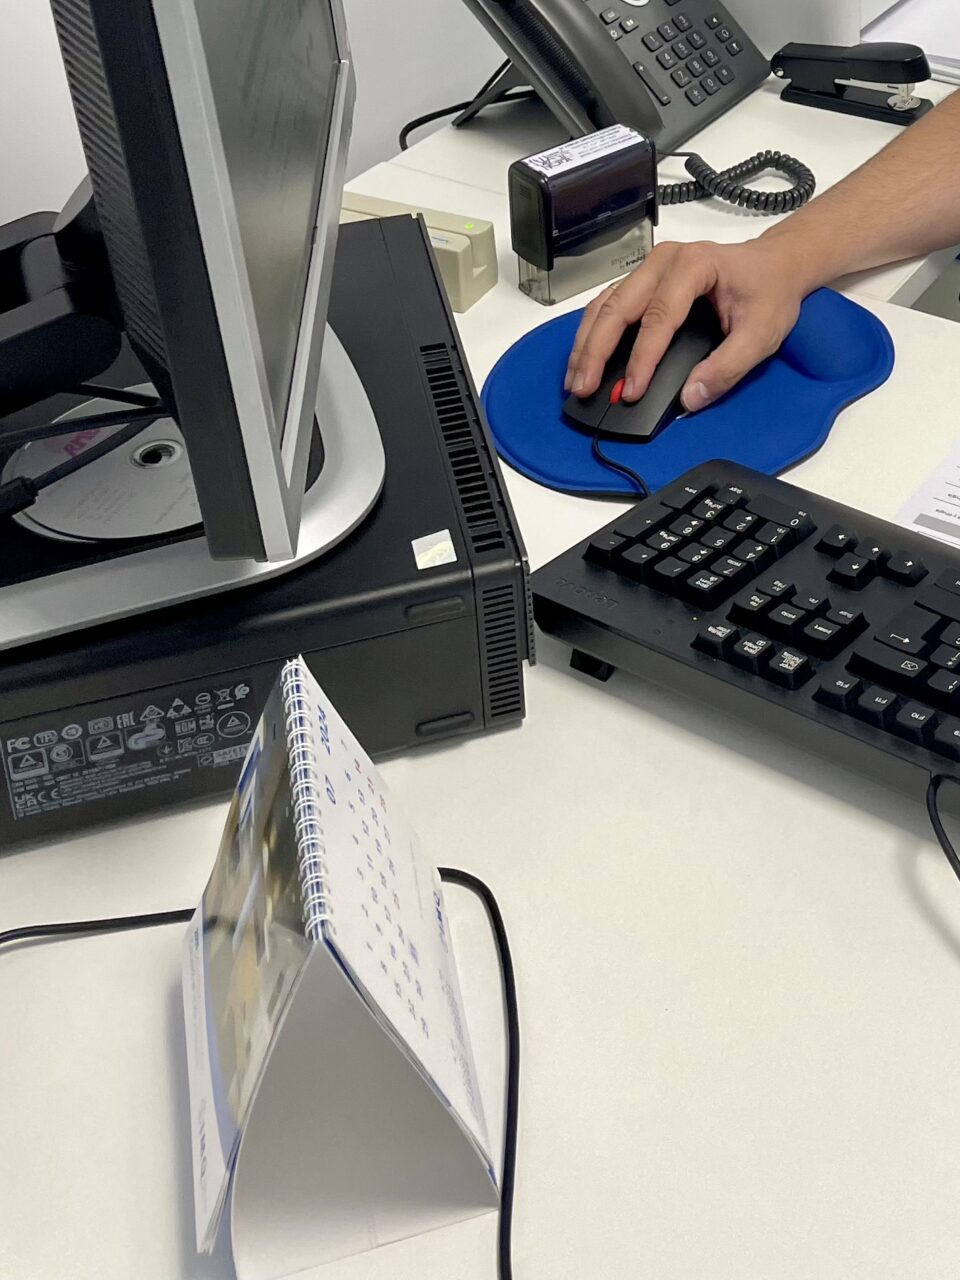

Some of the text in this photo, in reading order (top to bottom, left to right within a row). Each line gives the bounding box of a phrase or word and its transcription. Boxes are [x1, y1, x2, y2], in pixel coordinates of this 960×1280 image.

[705, 510, 715, 518] 3
[736, 522, 747, 530] 2
[790, 518, 800, 526] 0
[770, 535, 778, 543] 1
[835, 680, 850, 689] F12
[874, 696, 888, 704] F11
[911, 712, 926, 721] F10
[317, 704, 331, 756] 2024
